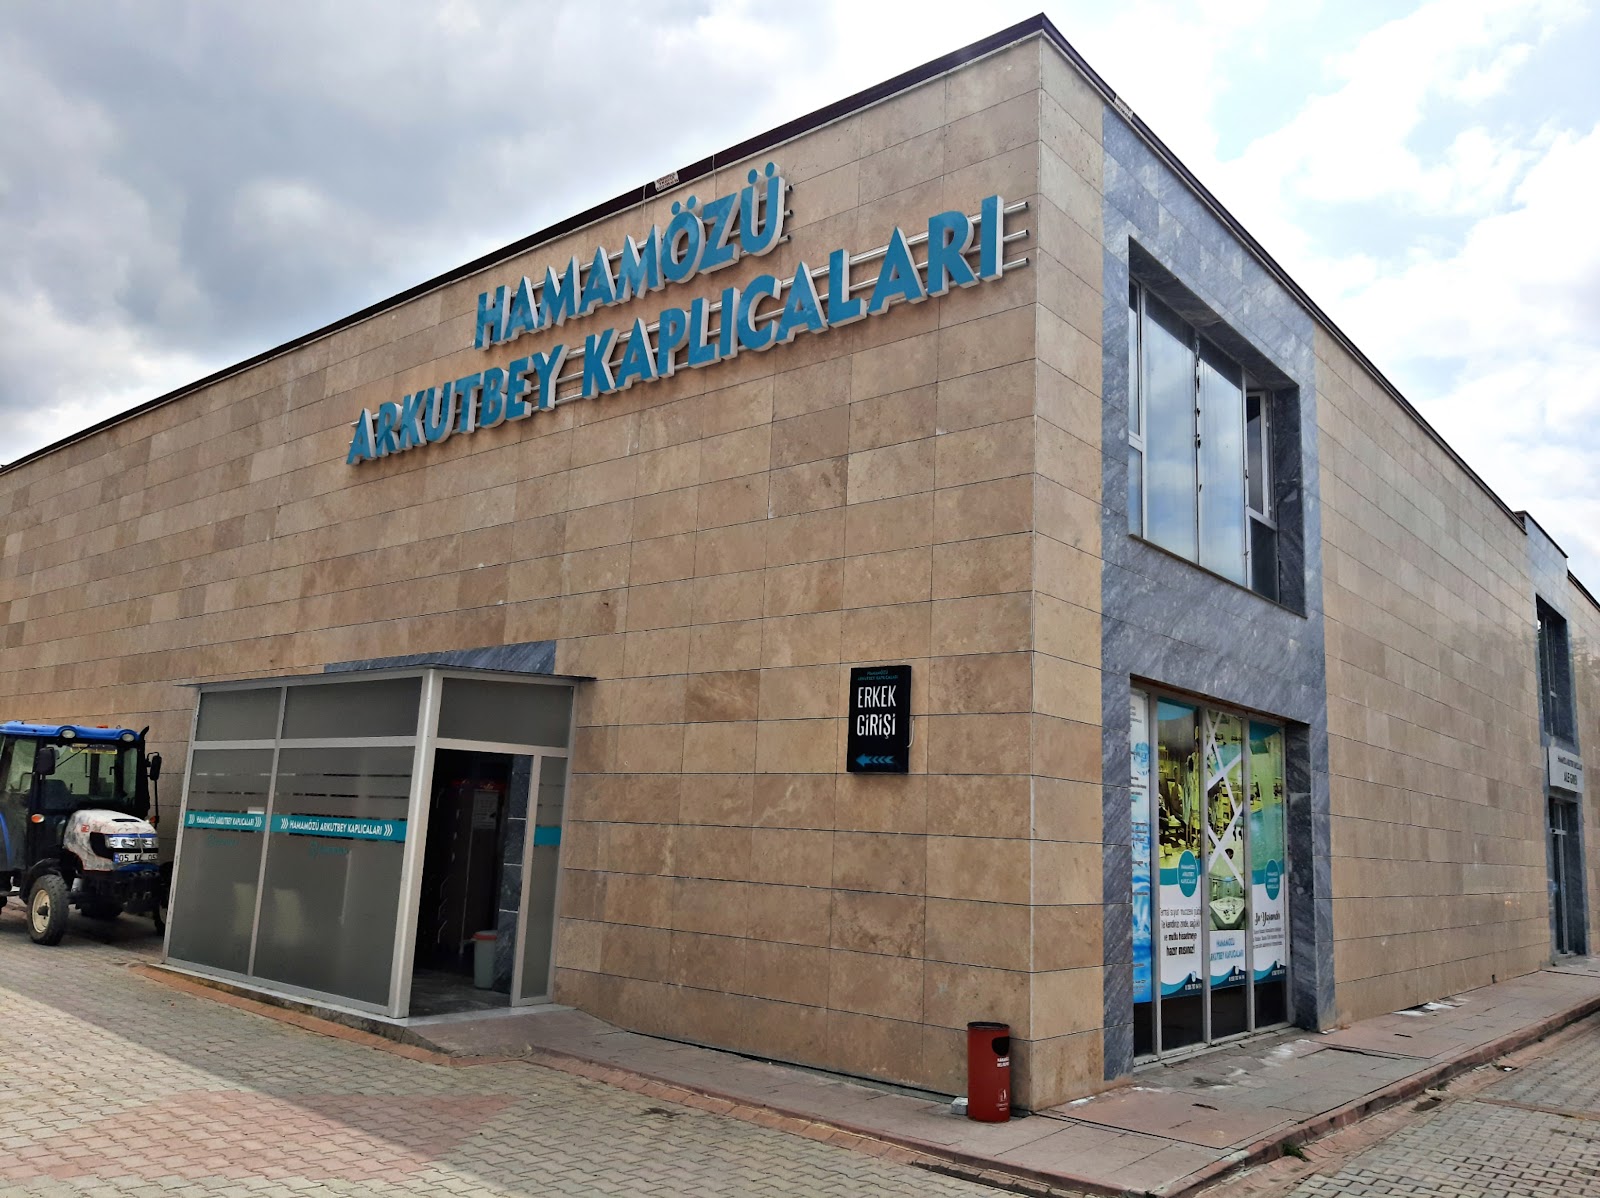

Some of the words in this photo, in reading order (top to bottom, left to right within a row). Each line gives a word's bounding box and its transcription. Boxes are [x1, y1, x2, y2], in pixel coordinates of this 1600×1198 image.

[474, 162, 787, 350] HAMAMÖZÜ
[346, 344, 569, 466] ARKUTBEY
[581, 195, 1005, 400] KAPLICALARI
[857, 684, 897, 709] ERKEK
[856, 713, 896, 739] GİRİŞİ
[289, 818, 320, 830] HAMAMÖZÜ
[319, 822, 347, 833] ARKUTBEY
[347, 823, 383, 836] KAPLICALARI
[119, 853, 129, 862] 05
